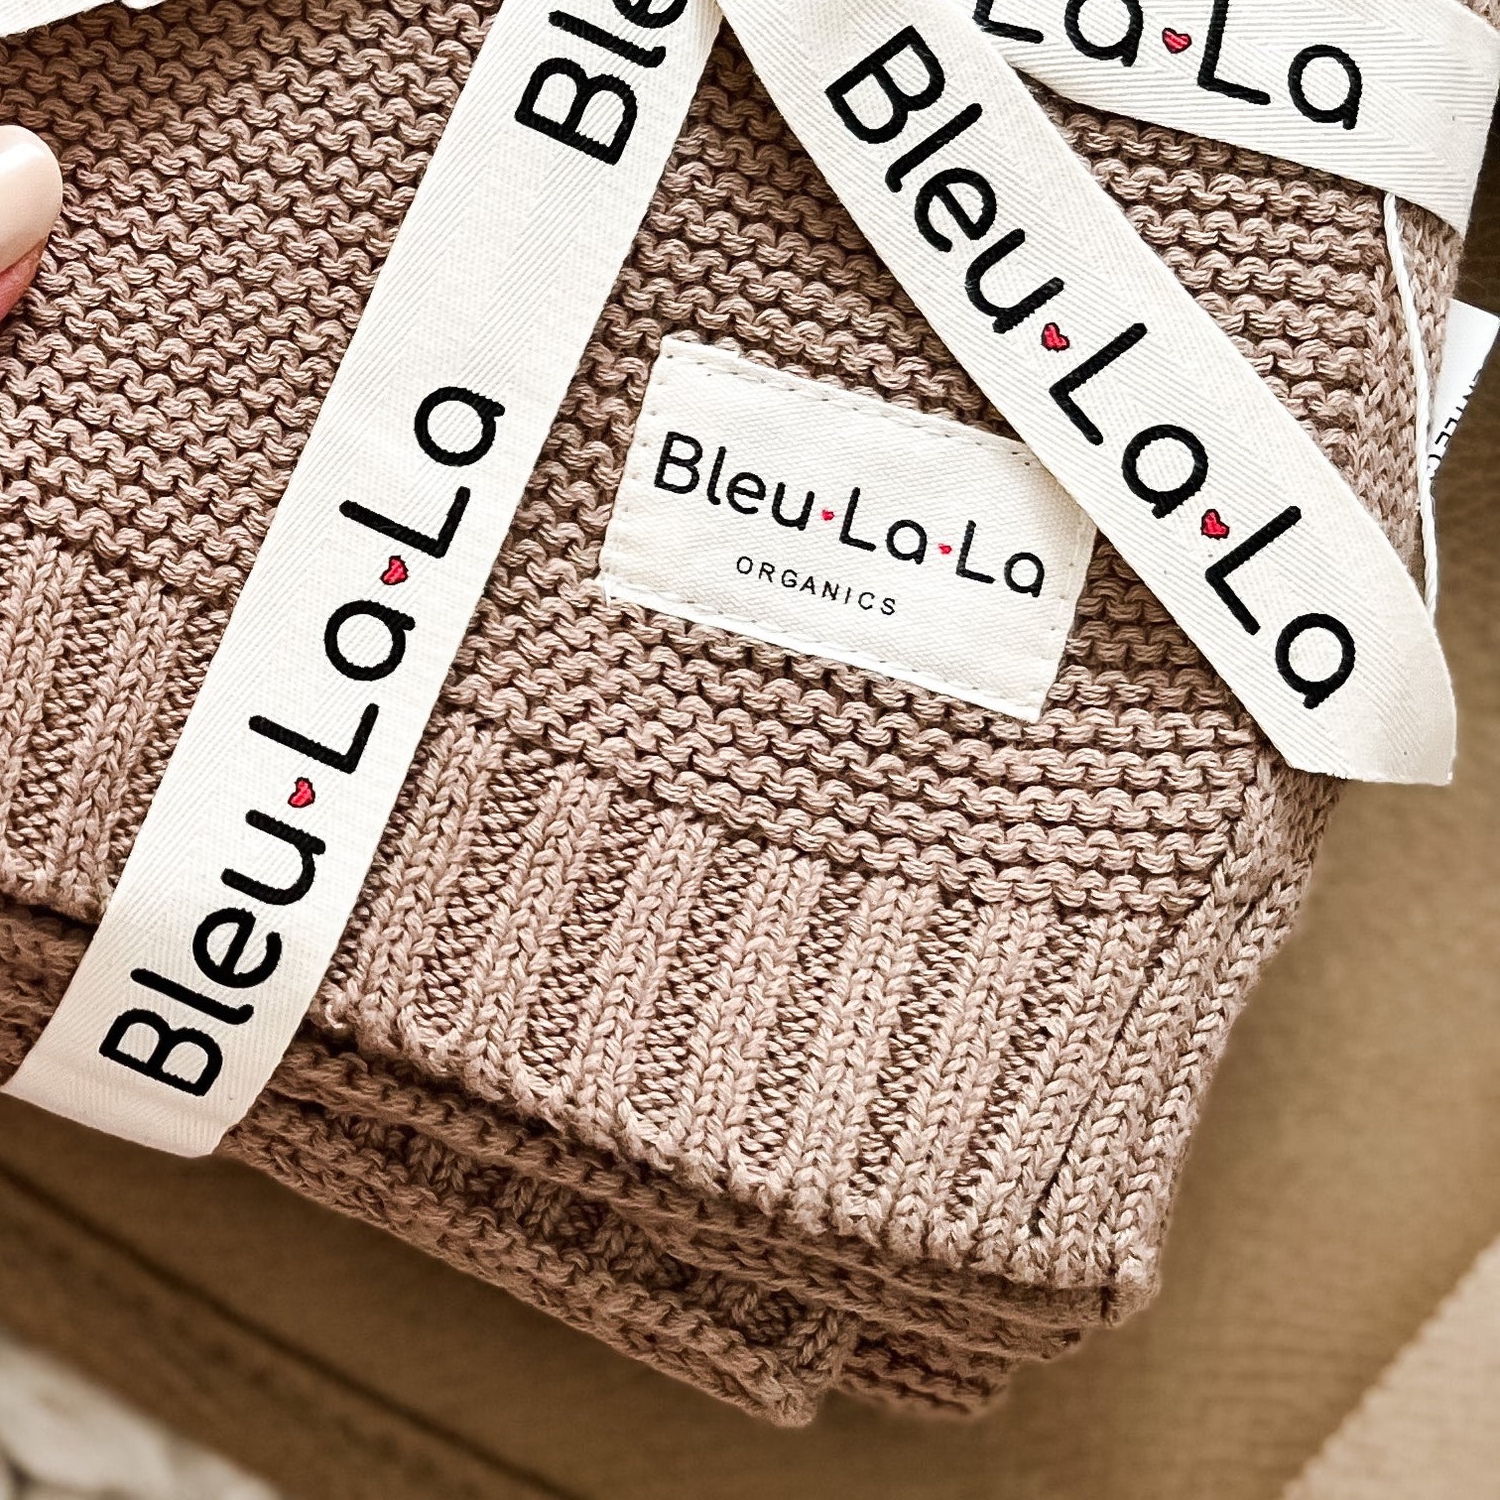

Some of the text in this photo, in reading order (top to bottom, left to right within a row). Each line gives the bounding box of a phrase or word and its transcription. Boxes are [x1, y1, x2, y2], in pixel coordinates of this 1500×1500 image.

[653, 431, 1045, 598] Bleu La La
[823, 24, 1357, 710] Bleu La La
[98, 385, 506, 1097] Bleu La La
[736, 555, 897, 616] ORGANICS
